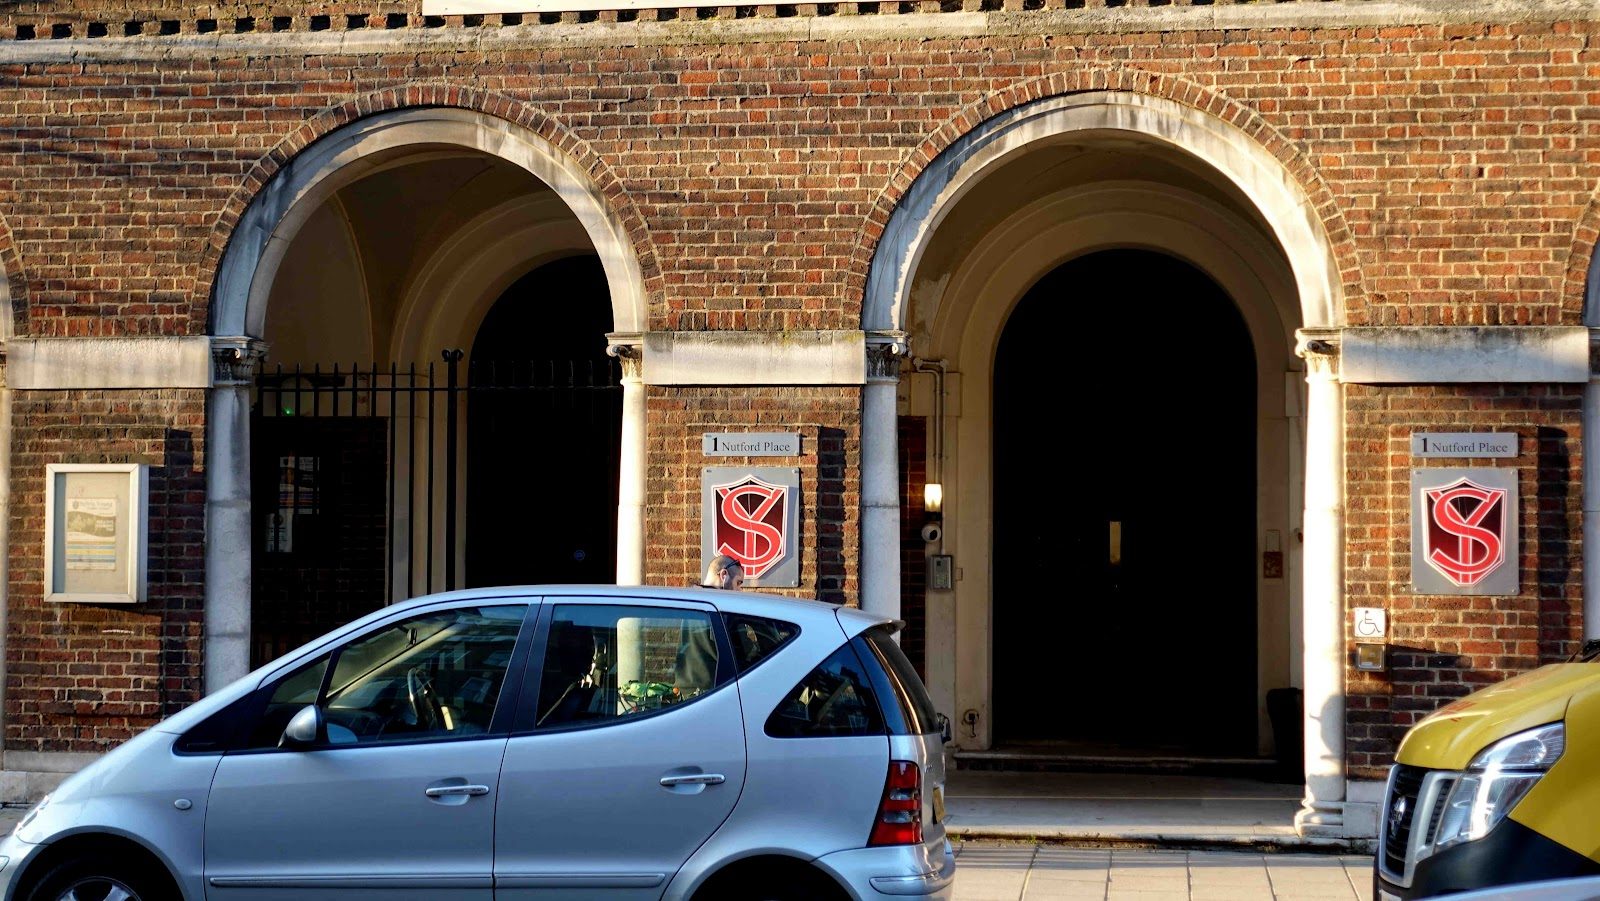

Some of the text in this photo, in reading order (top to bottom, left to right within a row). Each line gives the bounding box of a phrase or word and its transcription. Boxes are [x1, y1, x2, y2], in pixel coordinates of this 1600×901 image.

[712, 437, 791, 452] 1 Nutford Place
[1421, 437, 1508, 453] 1 Nutford Place
